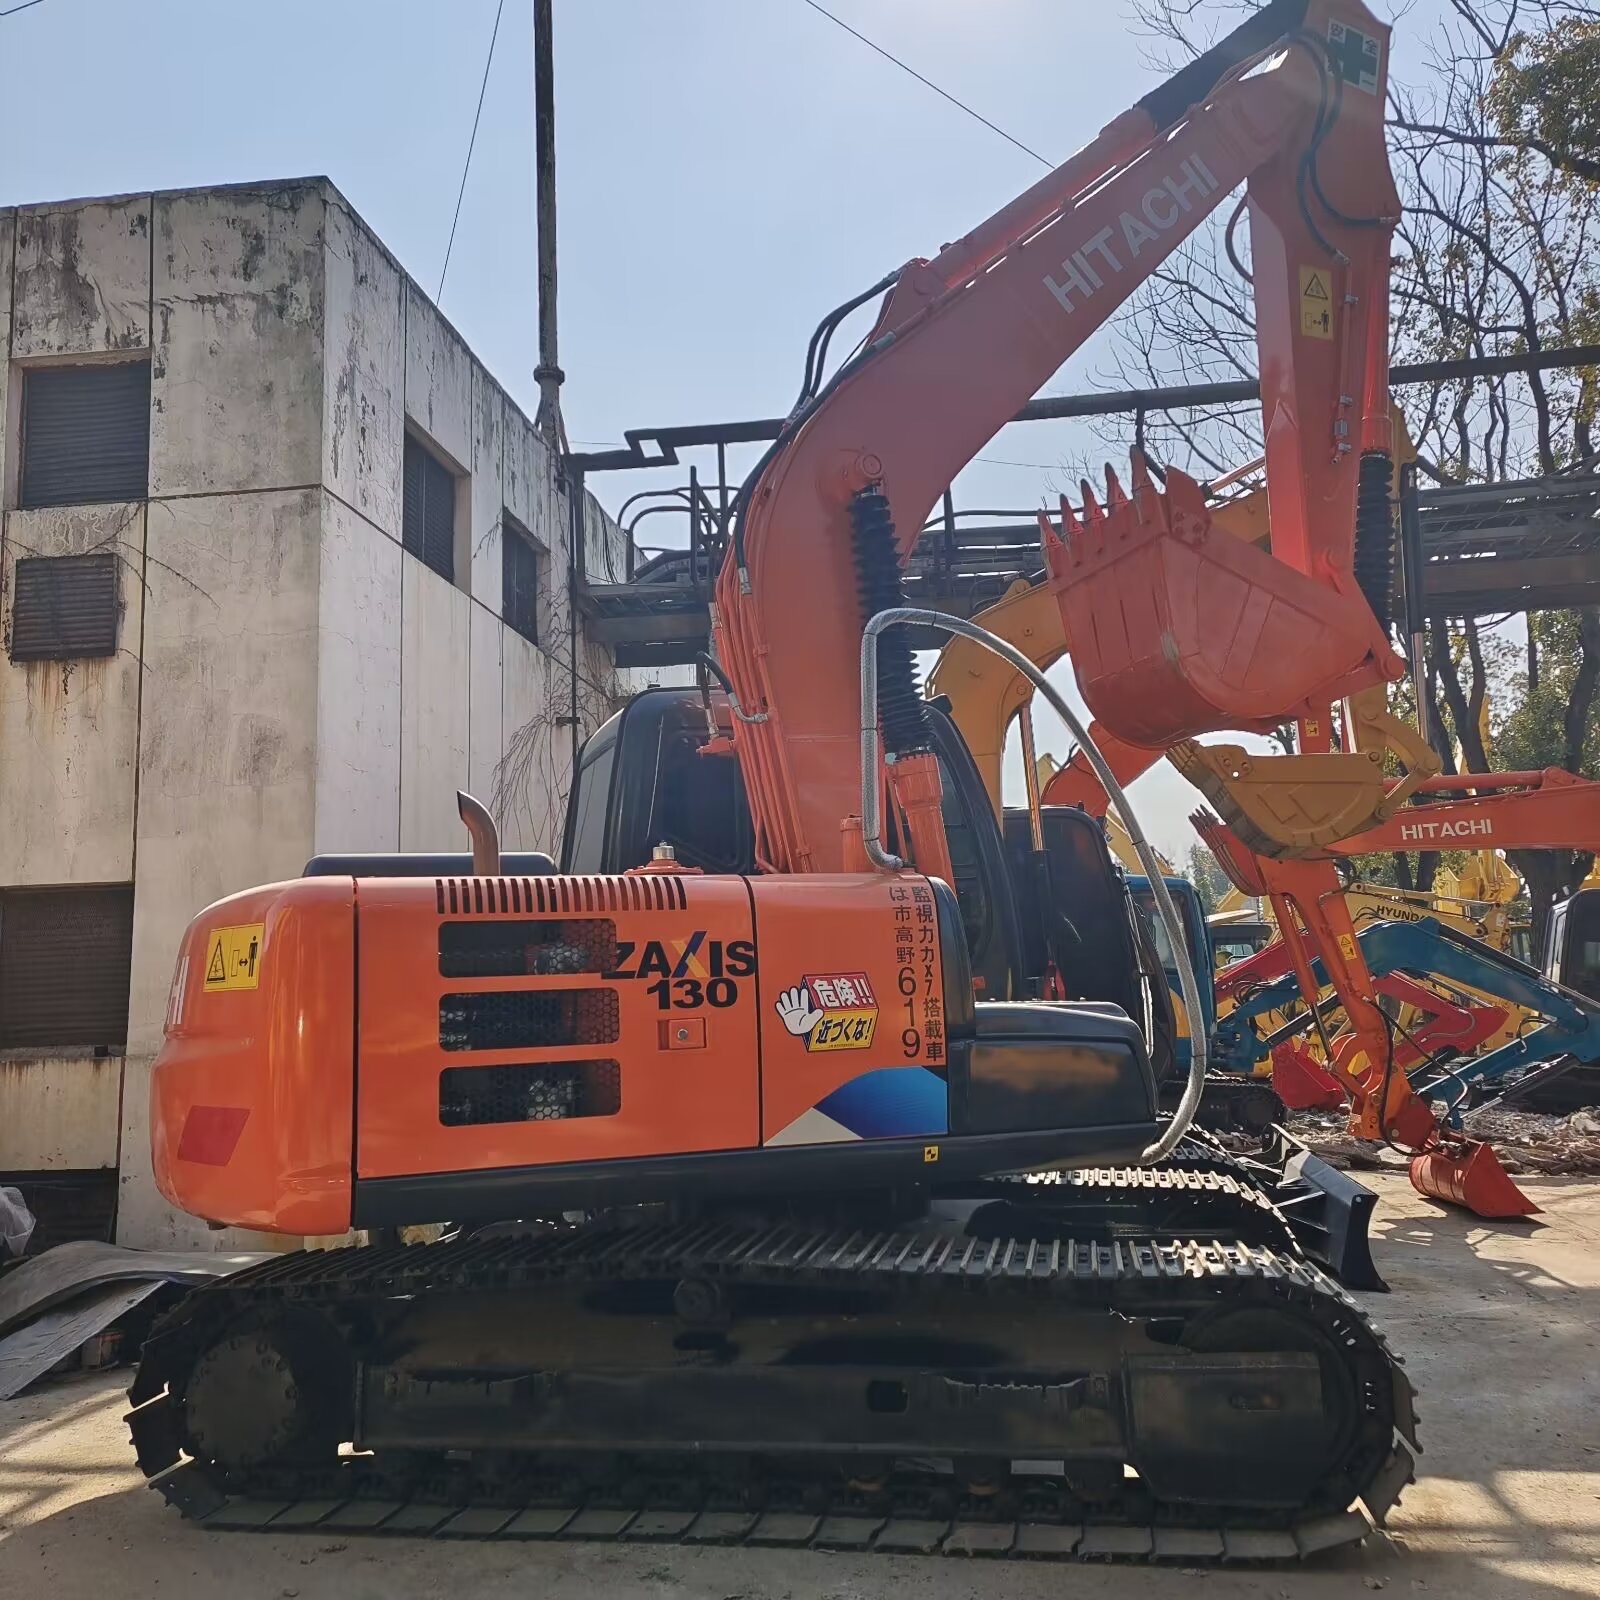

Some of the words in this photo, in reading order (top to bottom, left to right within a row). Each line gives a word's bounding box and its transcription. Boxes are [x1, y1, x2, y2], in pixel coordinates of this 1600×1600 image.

[1042, 152, 1220, 314] HITACHI
[1401, 819, 1493, 840] HITACHI
[600, 930, 755, 979] ZAXIS
[647, 977, 738, 1010] 130
[812, 977, 874, 1008] 危険!!
[816, 1017, 873, 1044] 近づくな!
